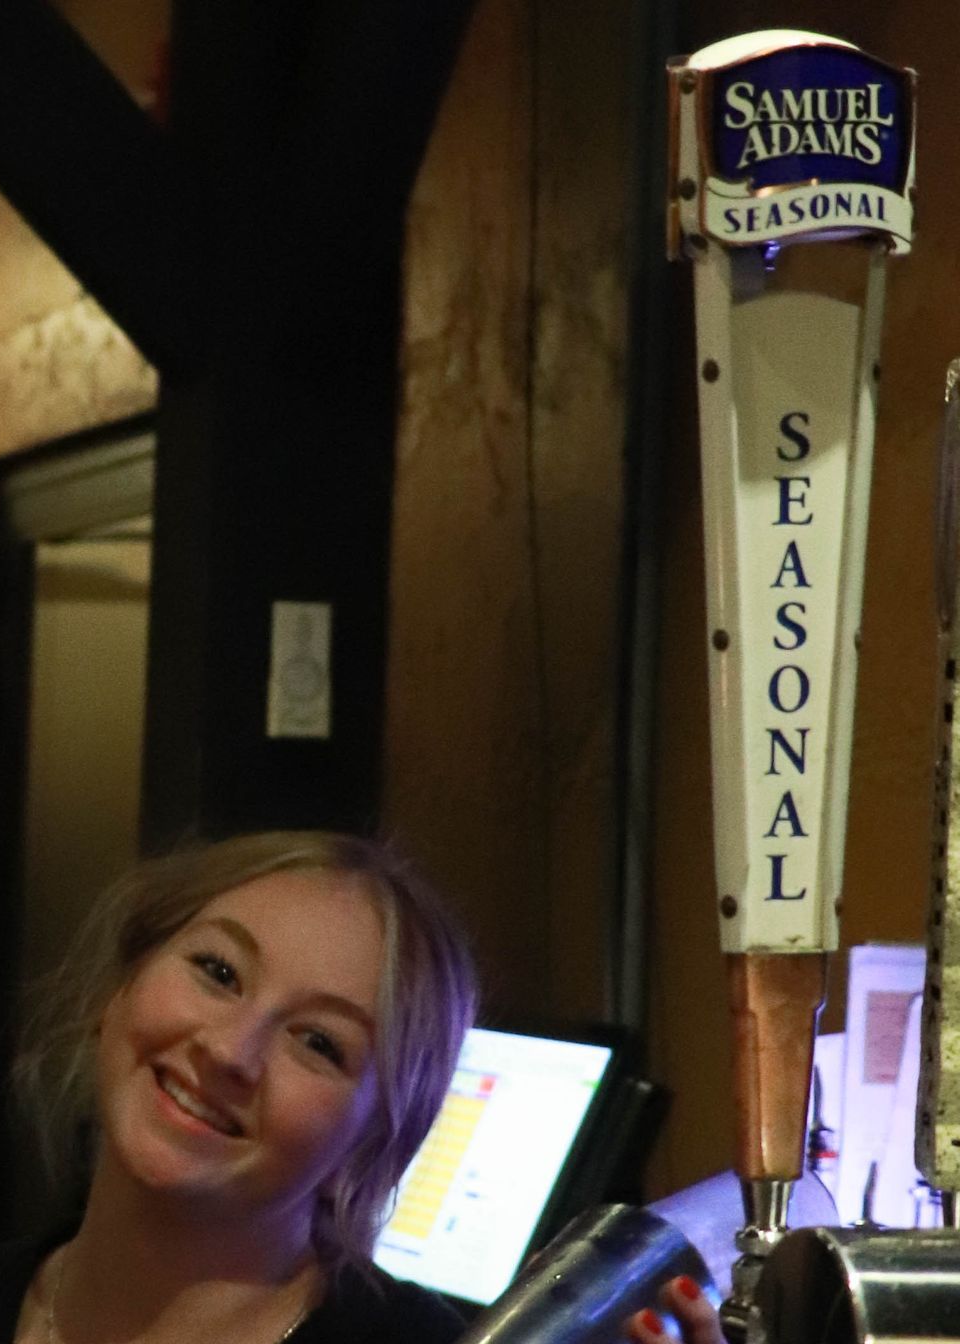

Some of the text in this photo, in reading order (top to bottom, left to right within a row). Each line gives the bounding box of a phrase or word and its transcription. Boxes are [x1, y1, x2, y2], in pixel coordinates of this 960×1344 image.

[725, 81, 894, 129] SAMUEL
[736, 123, 882, 169] ADAMS
[724, 192, 889, 234] SEASONAL
[763, 411, 814, 901] SEASONAL
